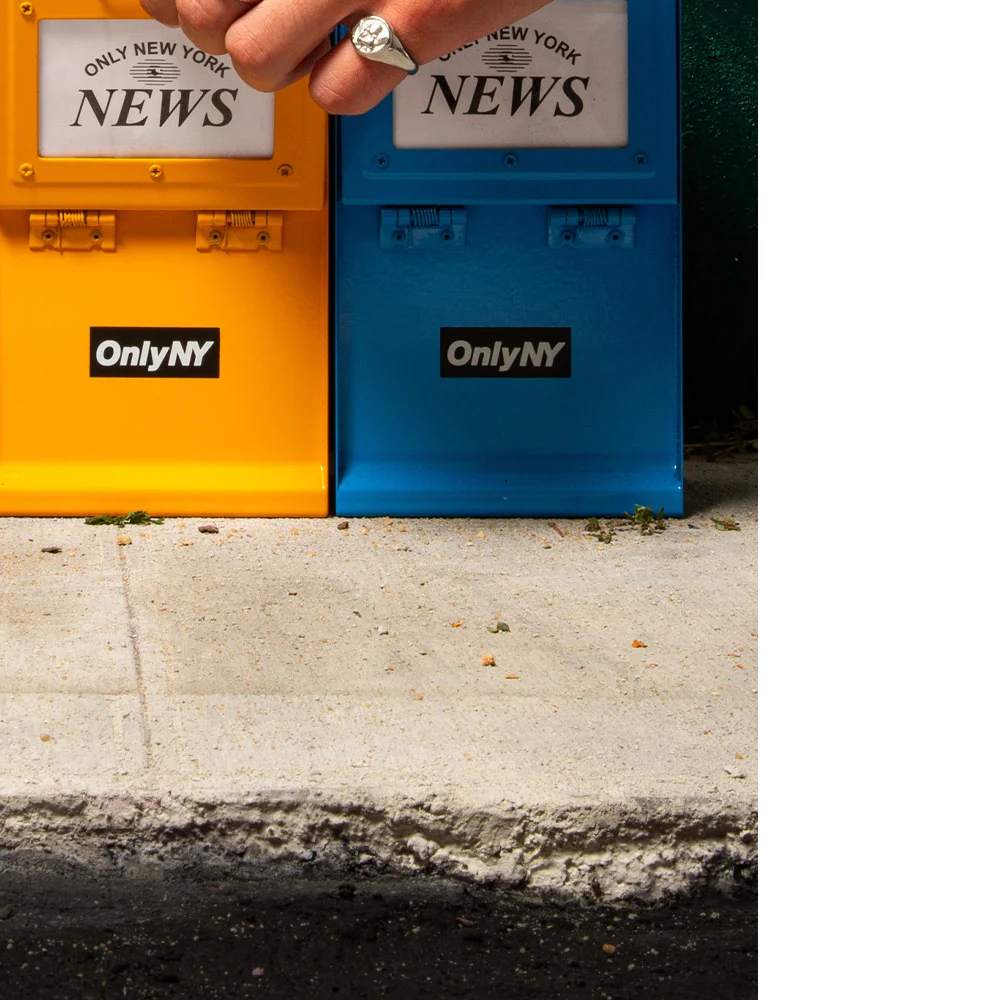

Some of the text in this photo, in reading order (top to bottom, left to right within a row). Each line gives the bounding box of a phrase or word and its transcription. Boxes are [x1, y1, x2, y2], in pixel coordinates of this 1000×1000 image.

[84, 41, 231, 79] ONLY NEW YORK
[487, 25, 582, 66] NEW YORK
[69, 88, 239, 128] NEWS
[420, 74, 590, 118] NEWS
[95, 338, 215, 373] OnlyNY
[445, 339, 567, 373] OnlyNY
